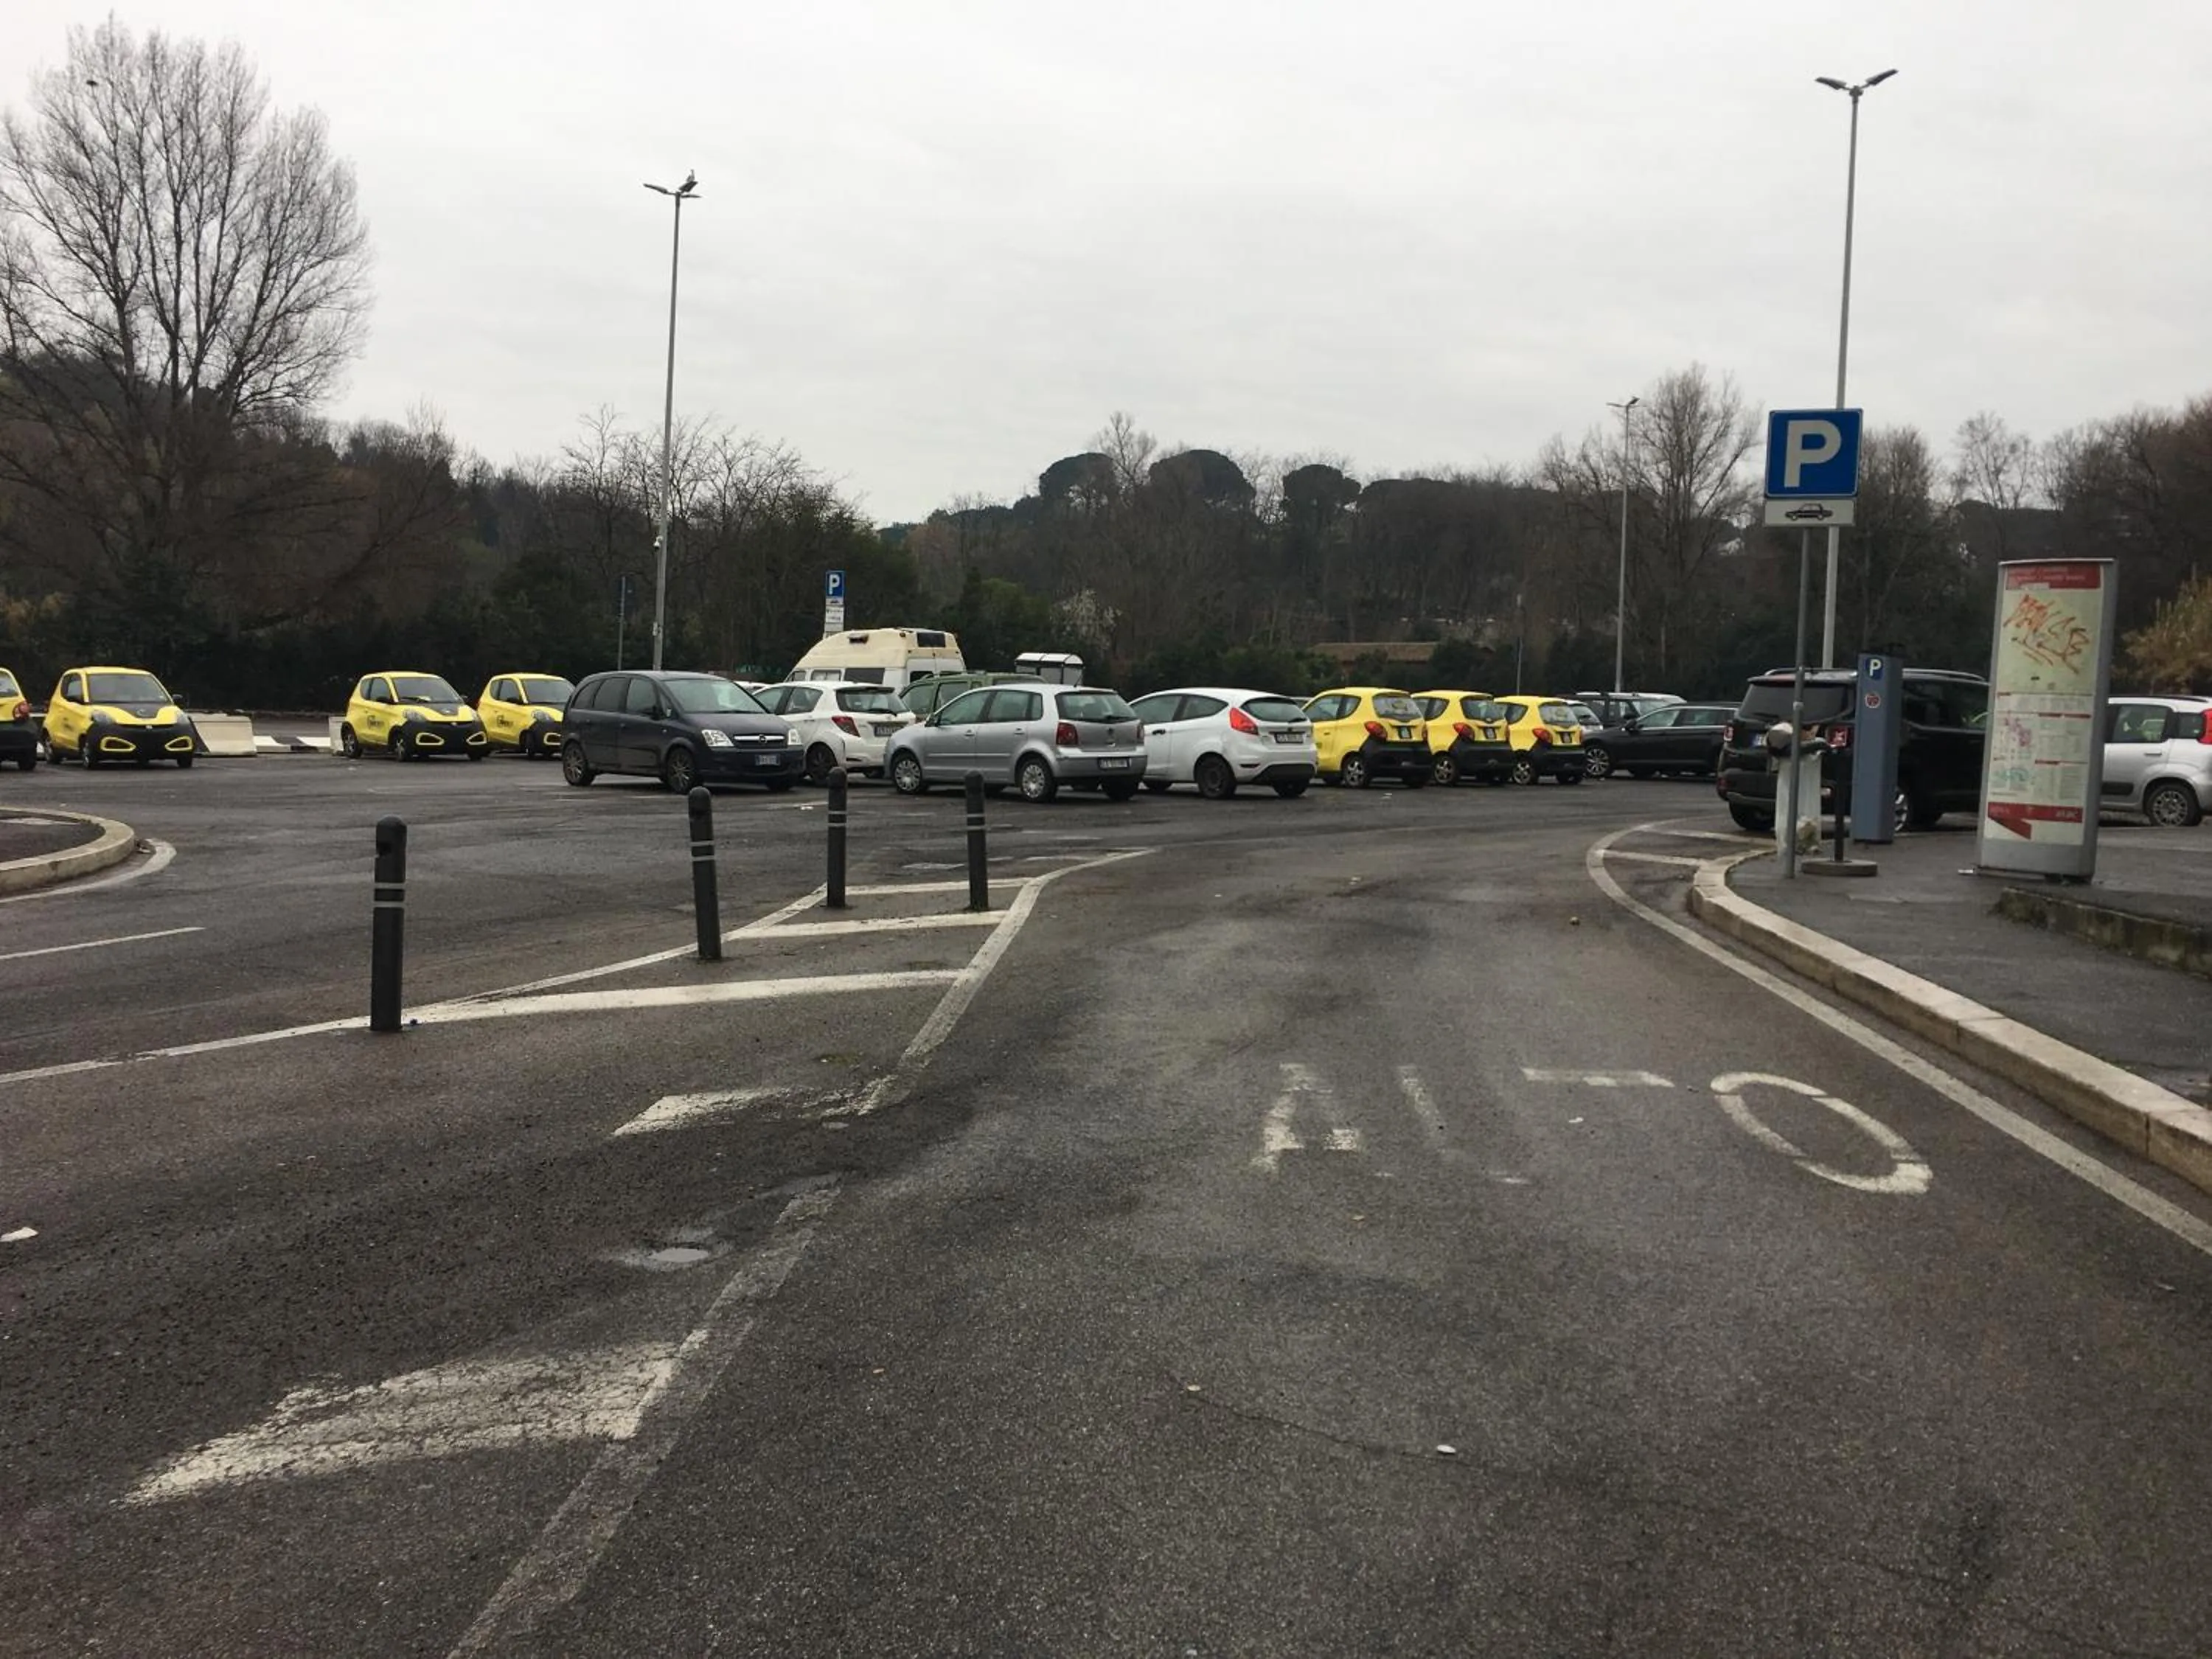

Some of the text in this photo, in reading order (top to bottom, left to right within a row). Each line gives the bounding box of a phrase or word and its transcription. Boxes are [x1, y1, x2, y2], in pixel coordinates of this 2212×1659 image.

[1784, 420, 1842, 487] P
[829, 574, 841, 595] P
[1869, 658, 1882, 676] P
